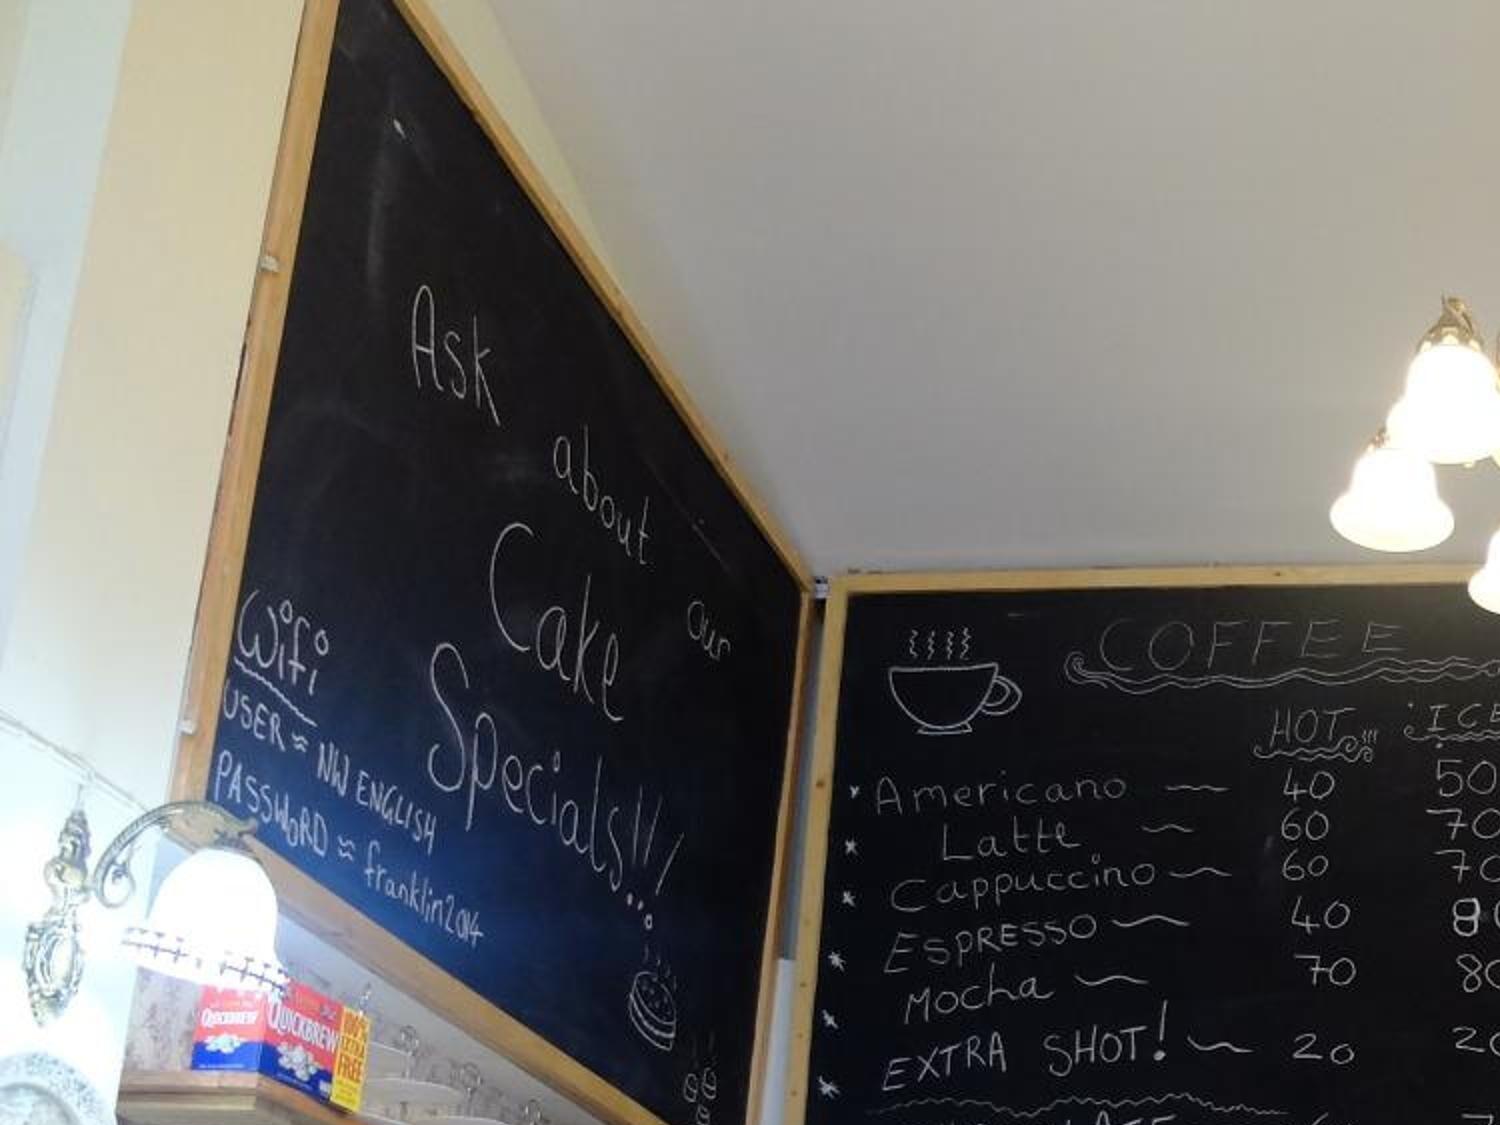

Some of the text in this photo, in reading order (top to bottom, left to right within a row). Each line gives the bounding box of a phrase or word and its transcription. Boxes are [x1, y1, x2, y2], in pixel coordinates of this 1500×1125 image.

[412, 285, 500, 426] Ask
[553, 424, 648, 564] about
[489, 522, 624, 722] Cake
[1100, 618, 1406, 672] COFFEE
[1269, 706, 1358, 745] HOT
[223, 678, 286, 751] USER
[357, 771, 437, 854] ENGLISH
[876, 770, 1127, 815] Americano
[1283, 767, 1336, 803] 40
[1436, 759, 1498, 797] 50
[213, 750, 328, 858] PASSWORD
[942, 816, 1082, 861] Latte
[1281, 808, 1330, 840] 60
[890, 852, 1156, 913] Cappuccino
[1282, 849, 1329, 881] 60
[1291, 895, 1351, 935] 40
[904, 962, 1055, 1025] Mocha
[1295, 954, 1357, 987] 70
[882, 1030, 1008, 1092] EXTRA
[1043, 999, 1168, 1078] SHOT!
[1292, 1032, 1355, 1066] 20
